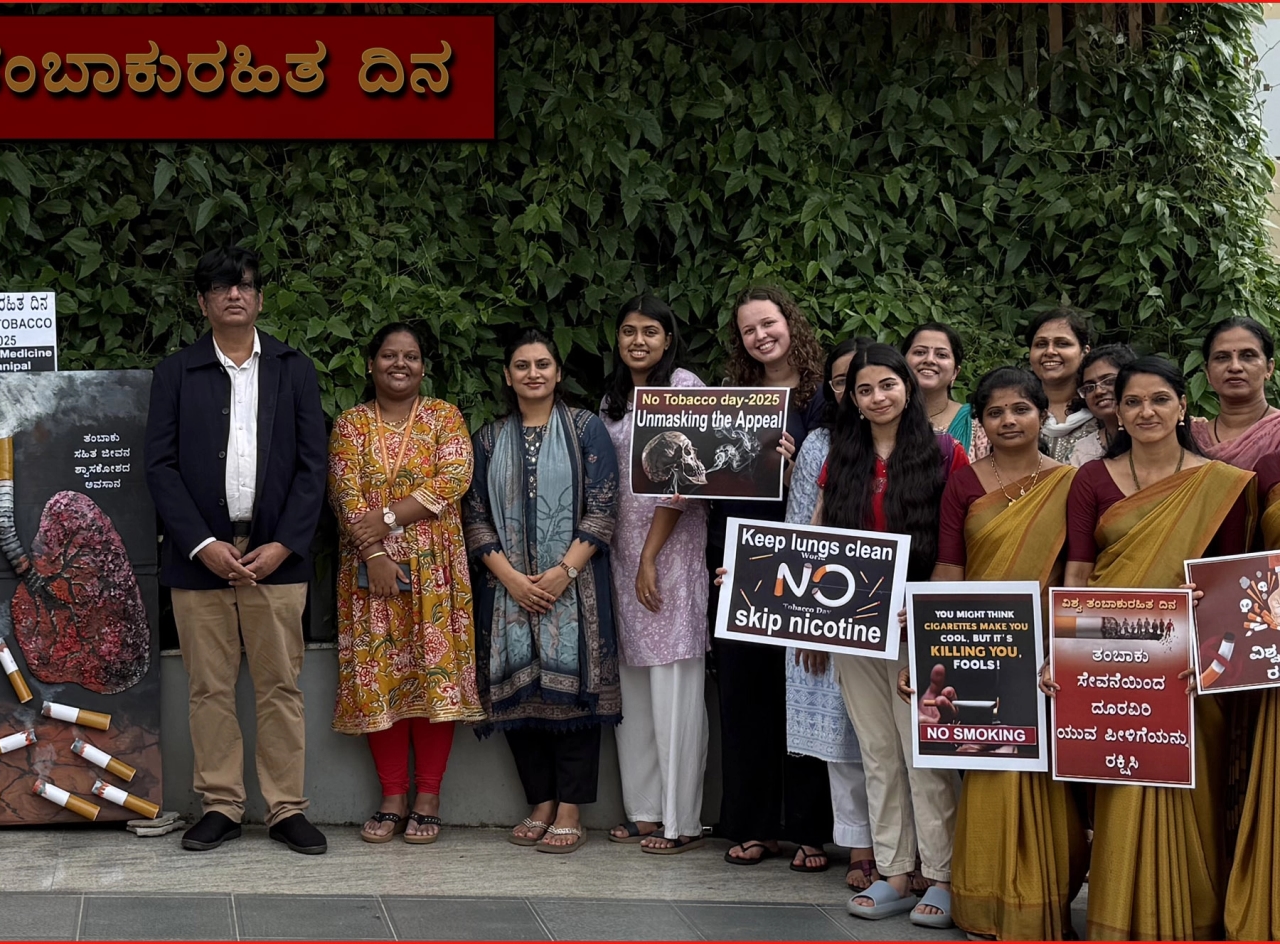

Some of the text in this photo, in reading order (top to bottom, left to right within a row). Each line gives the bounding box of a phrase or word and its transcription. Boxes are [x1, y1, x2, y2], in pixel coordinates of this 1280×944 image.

[30, 293, 48, 311] ದಿನ
[0, 349, 53, 359] Medicine
[642, 393, 780, 408] No Tobacco day-2025
[636, 409, 783, 432] Unmasking the Appeal
[741, 528, 893, 561] Keep lungs clean
[1062, 598, 1177, 613] ವಿಶ್ವ ತಂಬಾಕುರಹಿತ ದಿನ
[935, 610, 1014, 619] YOU MIGHT THINK
[735, 606, 881, 644] skip nicotine
[924, 623, 977, 631] CIGARETTES
[1009, 623, 1028, 631] YOU
[973, 634, 991, 643] BUT
[994, 634, 1013, 643] IT'S
[930, 646, 1022, 659] KILLING YOU,
[1092, 647, 1149, 663] ತಂಬಾಕು
[1250, 644, 1280, 663] ವಿಶ್ವ
[953, 660, 1000, 670] FOOLS!
[1077, 671, 1166, 690] ಸೇವನೆಯಿಂದ
[1091, 700, 1152, 716] ದೂರವಿರಿ
[927, 727, 1026, 742] NO SMOKING
[1056, 725, 1097, 740] ಯುವ
[1105, 753, 1139, 776] ರಕ್ಷಿಸಿ
